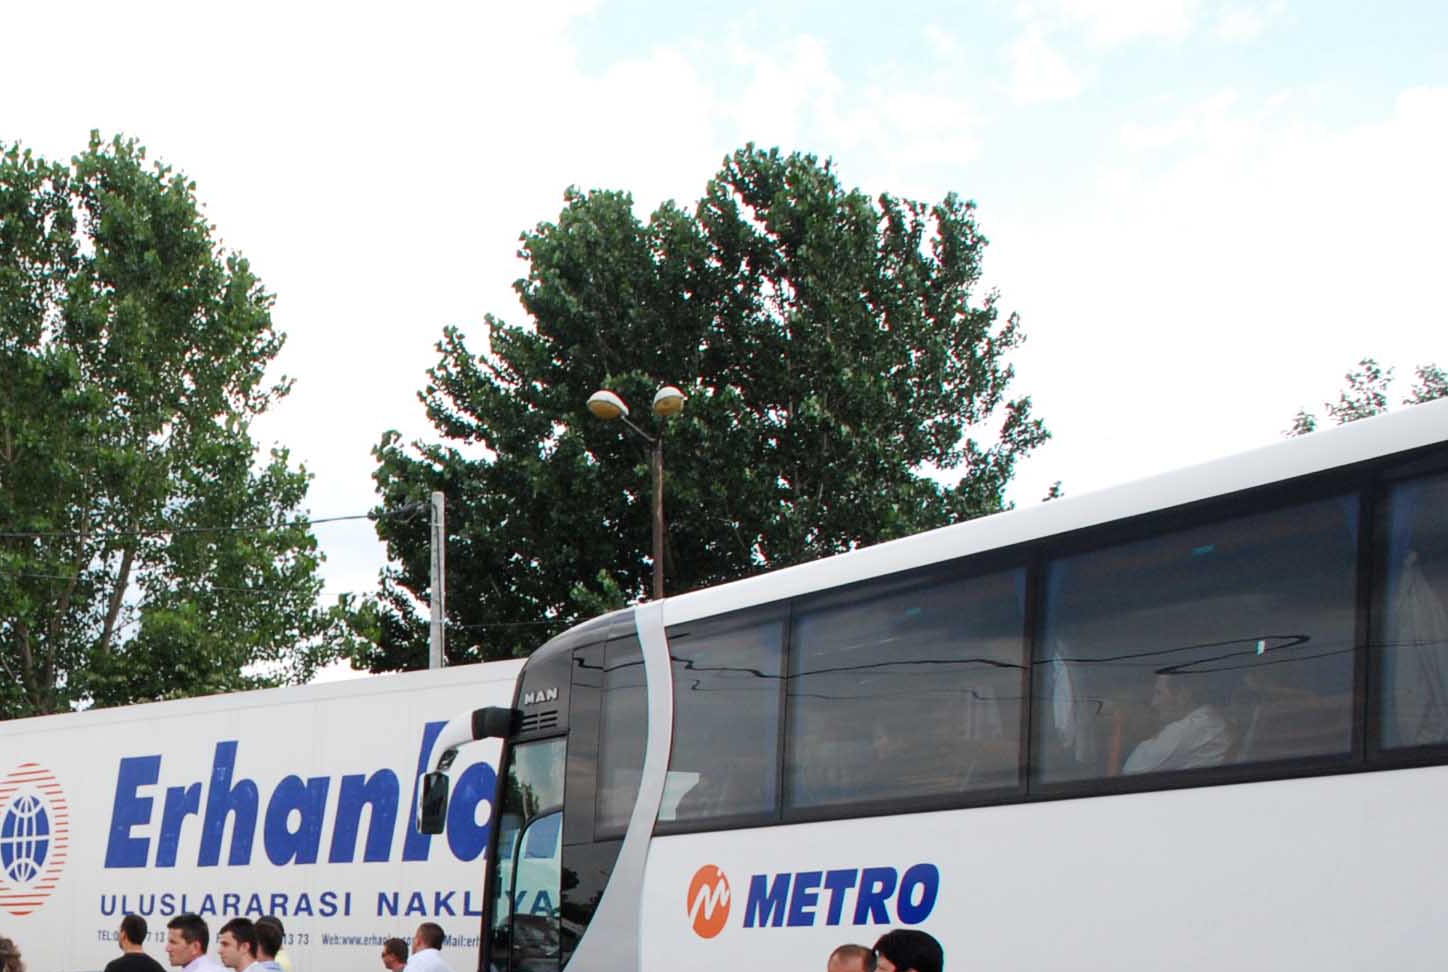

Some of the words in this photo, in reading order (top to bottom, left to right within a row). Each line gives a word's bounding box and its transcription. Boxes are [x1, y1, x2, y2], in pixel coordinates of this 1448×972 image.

[524, 687, 559, 705] MAN
[104, 720, 498, 868] Erhanla
[100, 891, 352, 917] ULUSLARARASI
[743, 863, 941, 928] METRO
